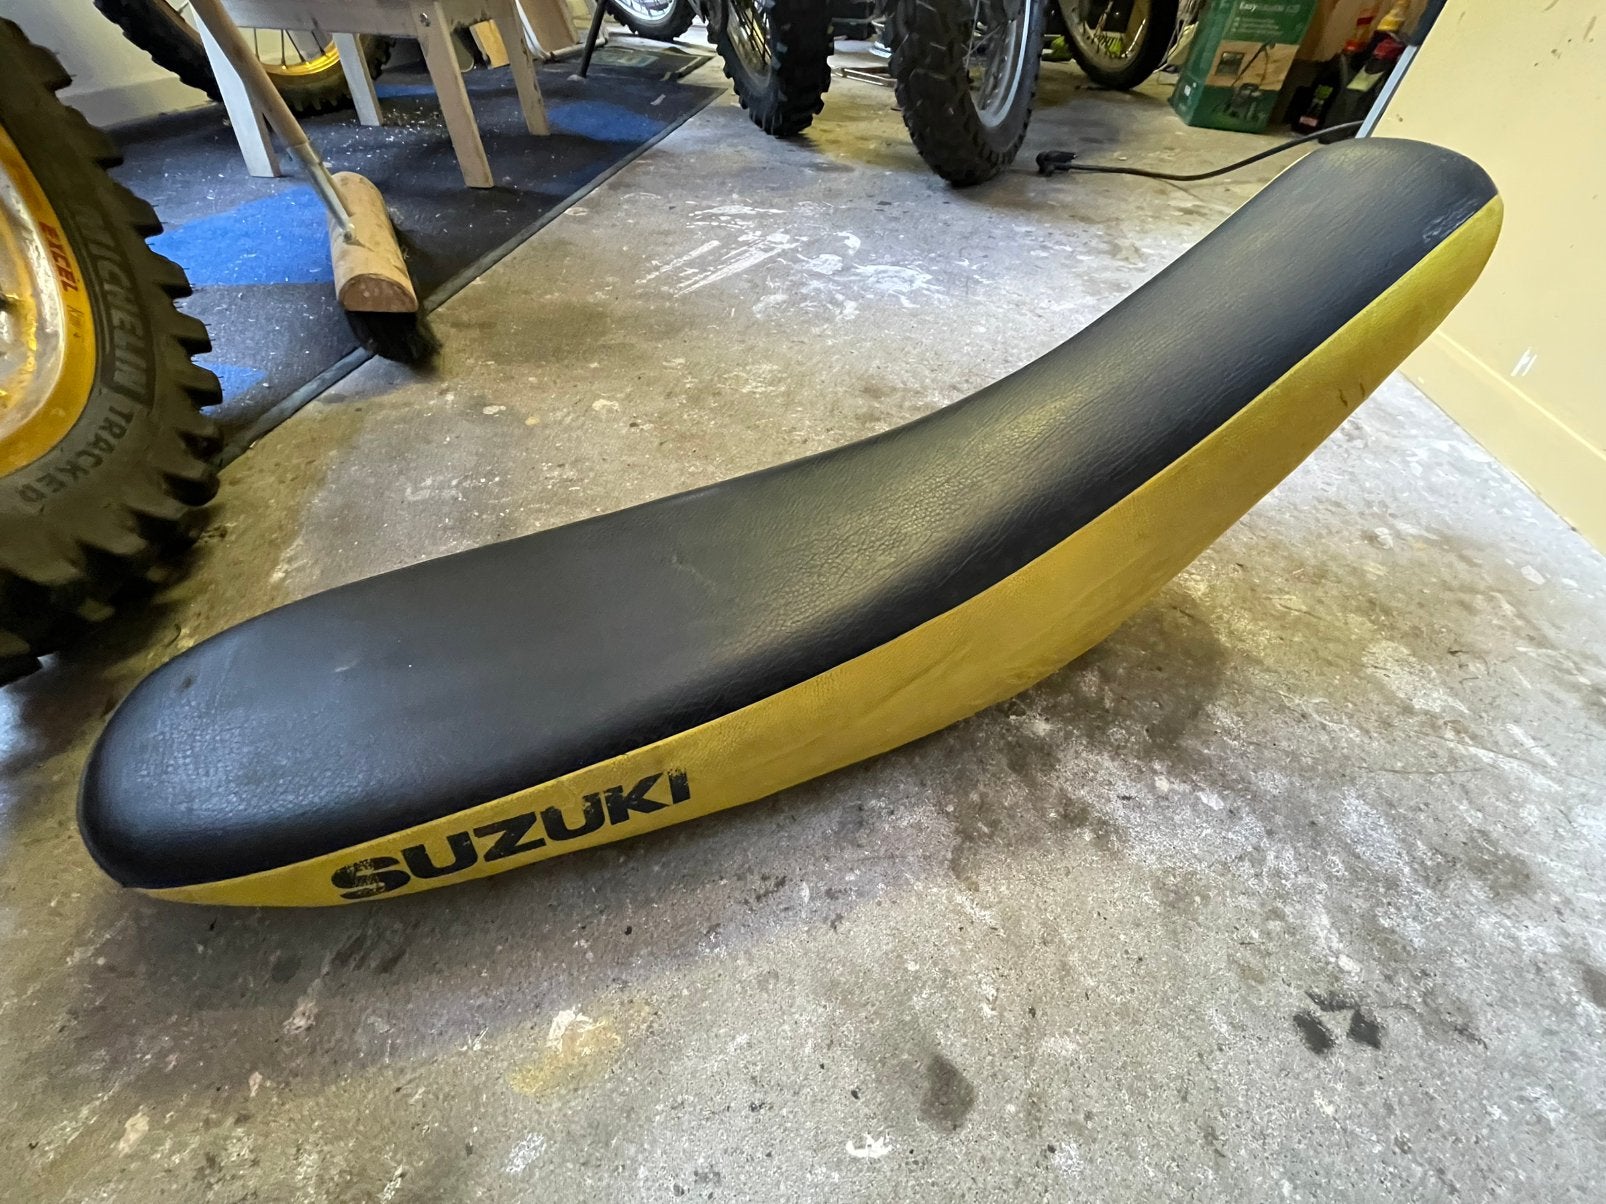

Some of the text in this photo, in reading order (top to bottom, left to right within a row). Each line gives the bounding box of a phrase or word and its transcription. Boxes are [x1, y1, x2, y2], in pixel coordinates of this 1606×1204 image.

[39, 221, 78, 292] EXCEL
[18, 406, 135, 502] TRACKED
[331, 768, 691, 900] SUZUKI
